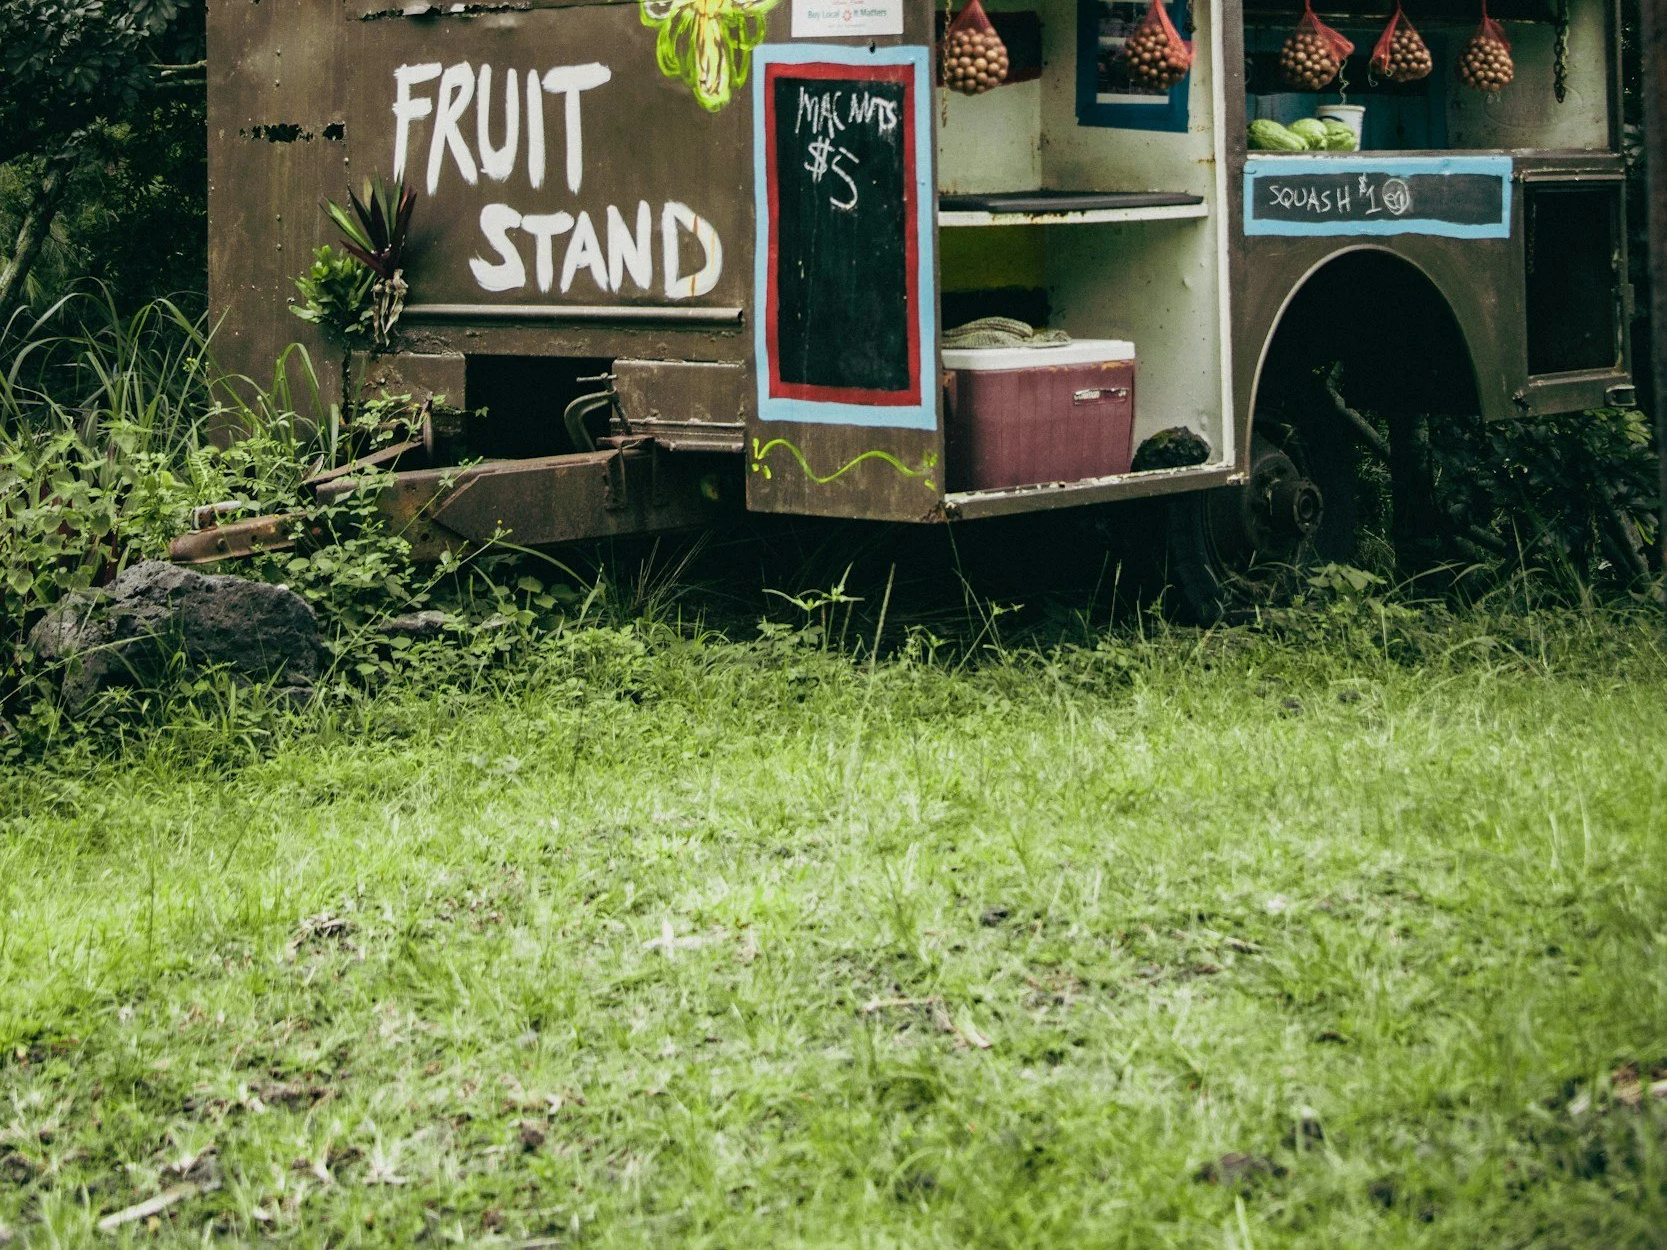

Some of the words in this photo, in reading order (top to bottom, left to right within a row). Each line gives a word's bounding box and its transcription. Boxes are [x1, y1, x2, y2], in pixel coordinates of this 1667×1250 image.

[808, 10, 820, 21] Buy
[822, 9, 840, 19] Local
[860, 8, 888, 18] Matters
[392, 61, 611, 196] FRUIT
[795, 86, 846, 139] MAC
[804, 135, 860, 210] $5
[1269, 184, 1351, 214] SQUASH
[469, 199, 724, 299] STAND
